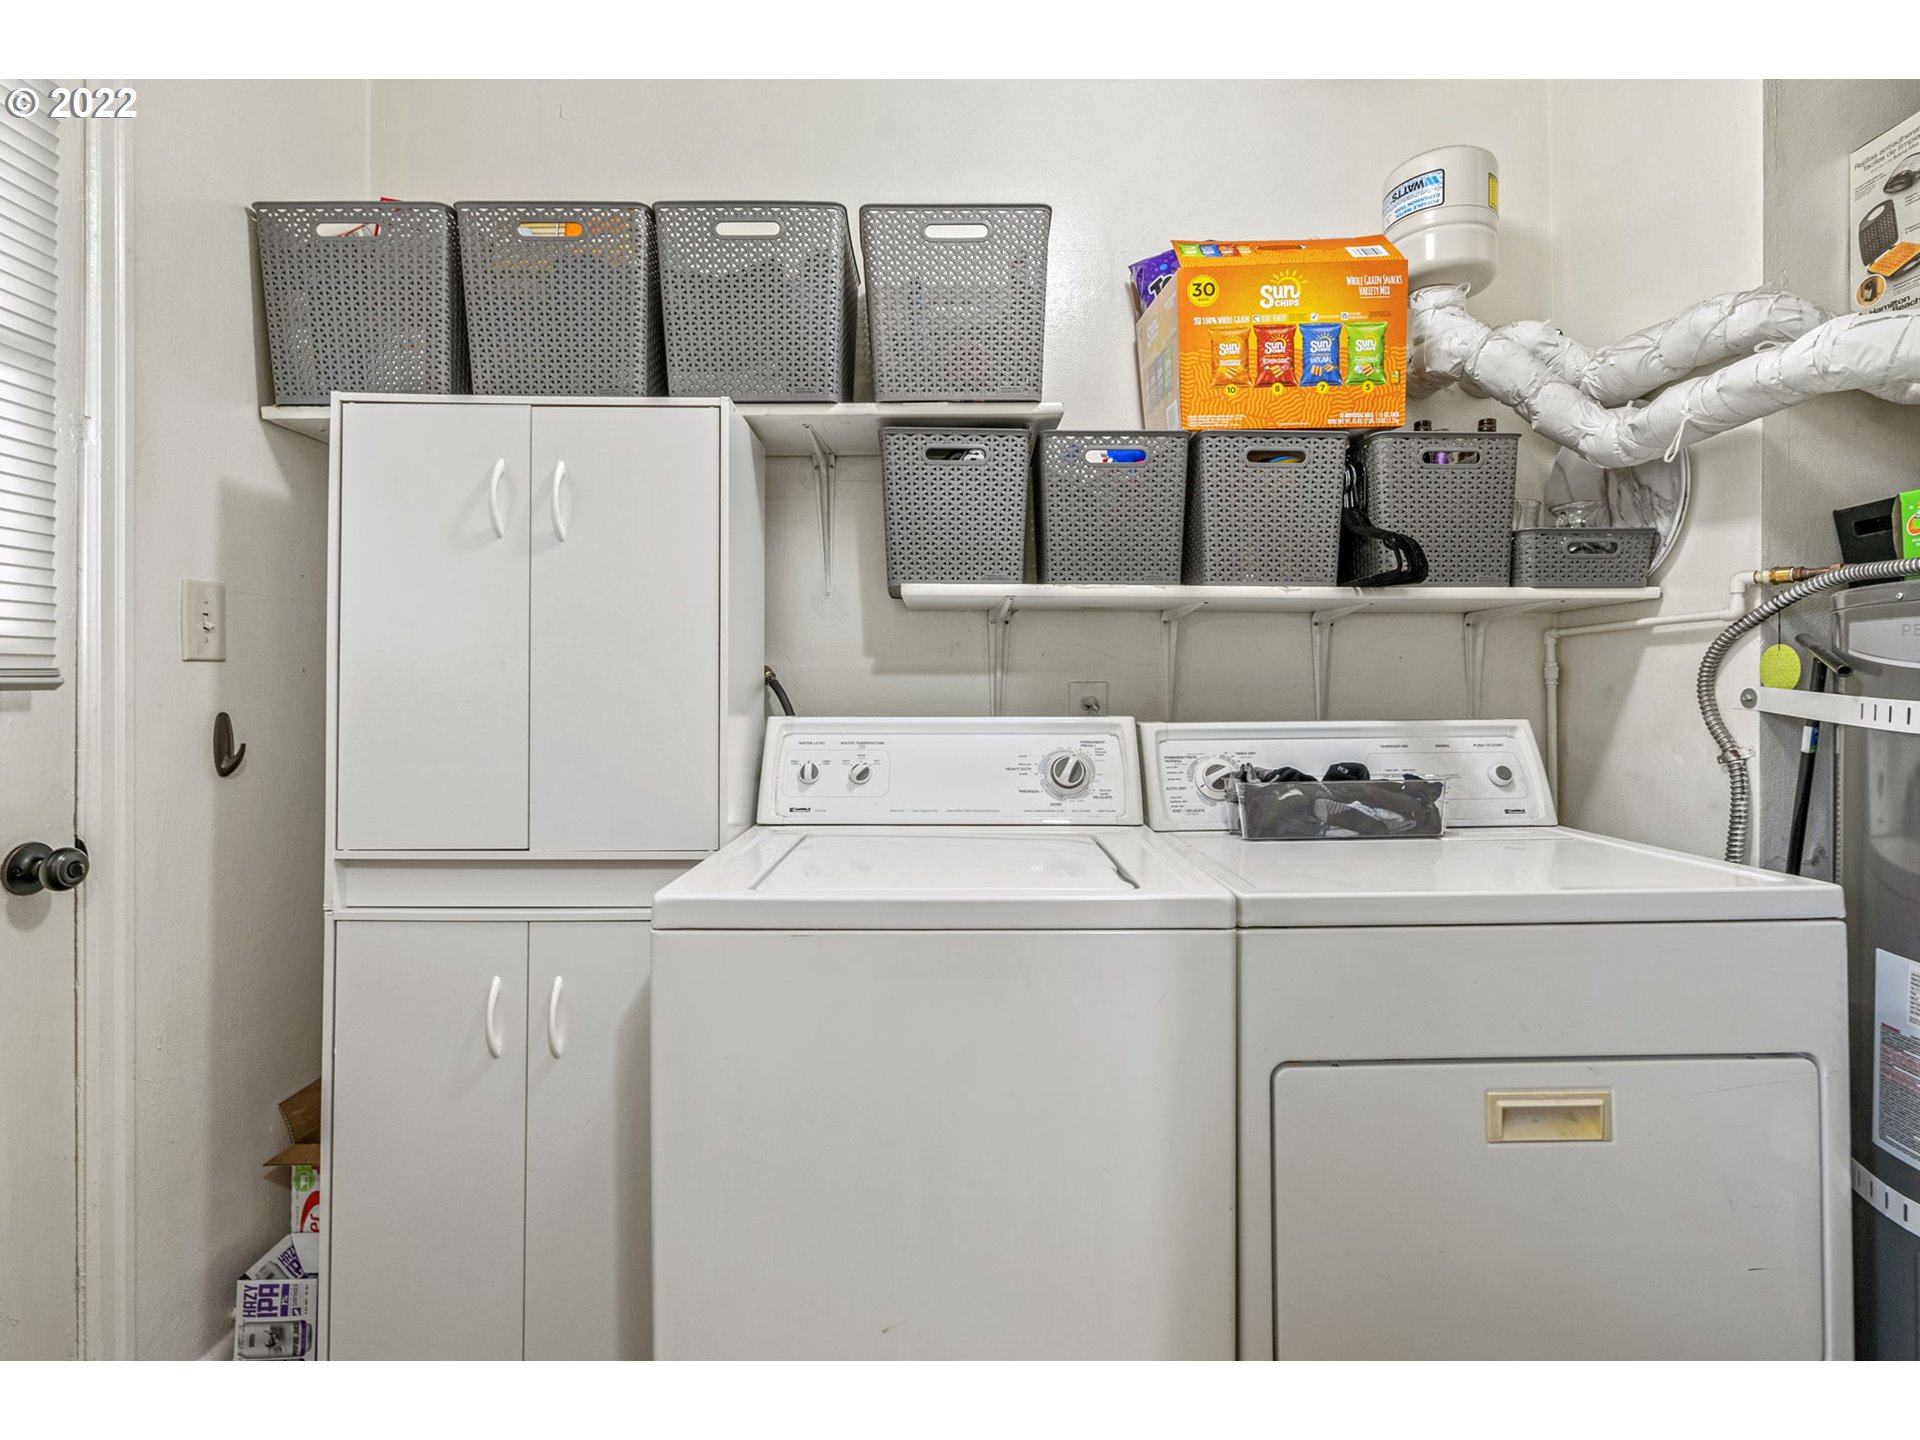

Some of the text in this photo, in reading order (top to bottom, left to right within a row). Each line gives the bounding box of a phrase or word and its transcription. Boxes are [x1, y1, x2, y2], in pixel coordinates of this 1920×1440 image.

[1392, 179, 1424, 202] WATTS
[1346, 276, 1364, 286] WHOLE
[1382, 274, 1403, 284] SNACKS
[1192, 282, 1215, 297] 30
[1379, 285, 1391, 295] MIX
[1260, 284, 1301, 309] Sun
[1274, 299, 1300, 307] CHIPS
[1219, 343, 1240, 356] Sun
[1264, 341, 1286, 354] Sun
[1310, 340, 1332, 353] Sun
[1355, 339, 1377, 352] Sun
[242, 1284, 258, 1318] HAZY
[257, 1283, 280, 1318] IPA
